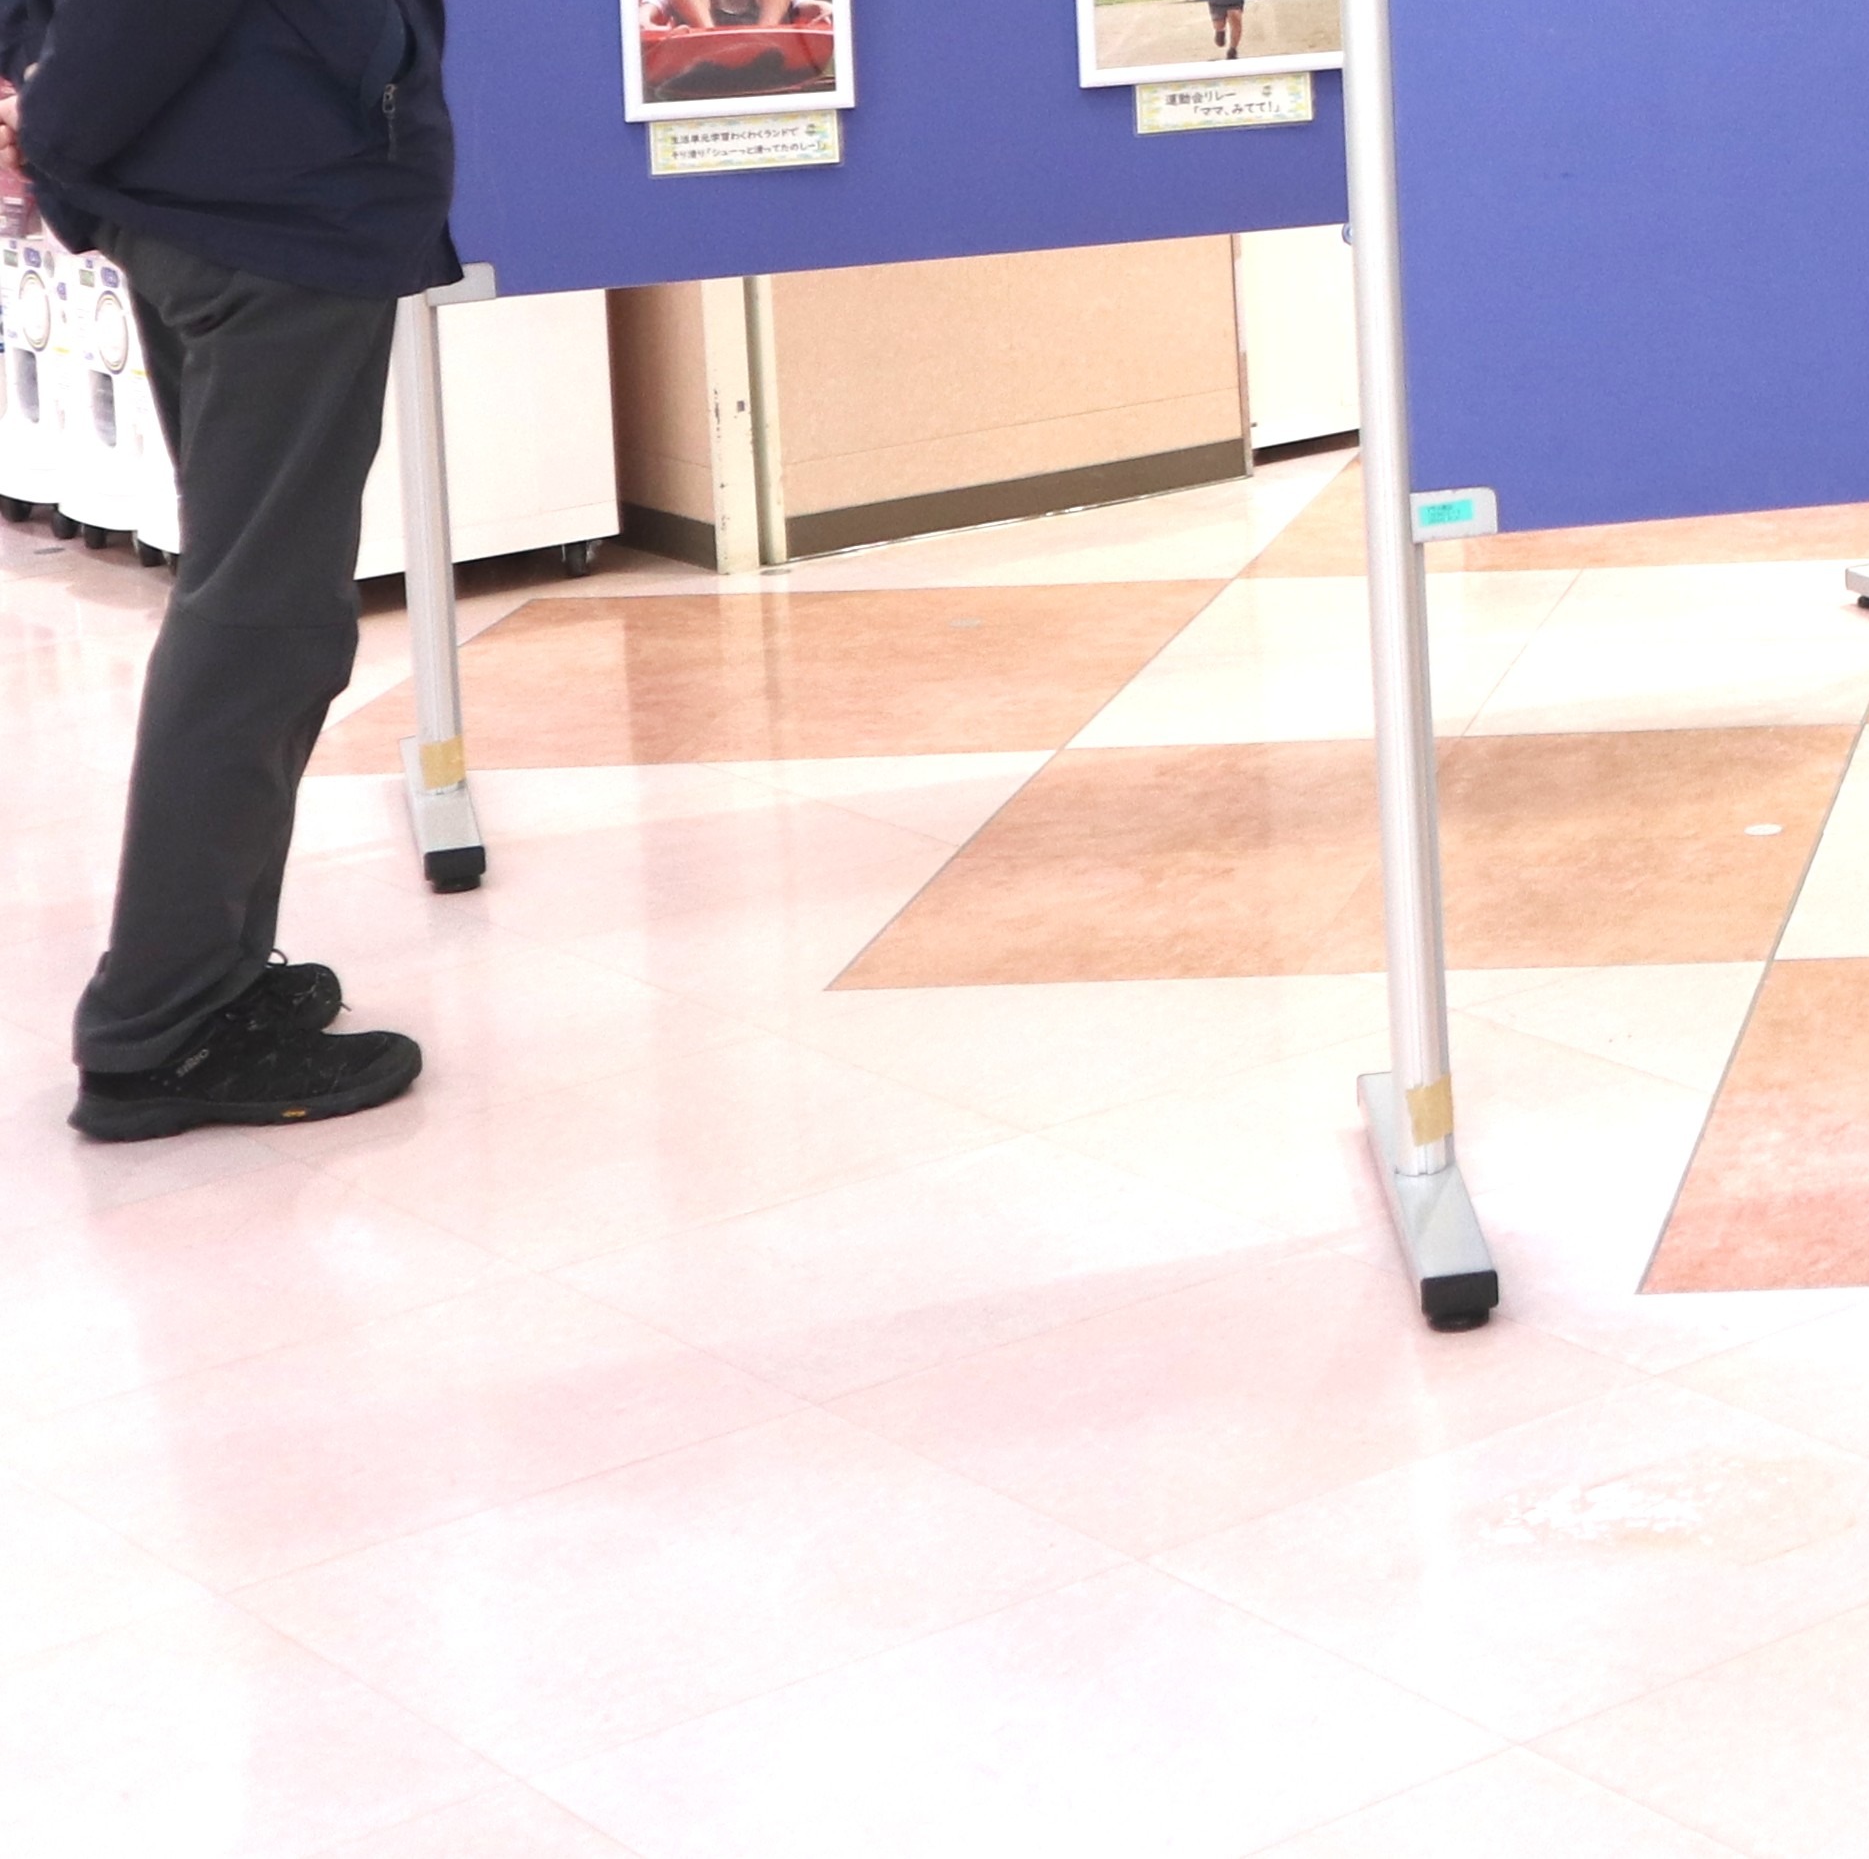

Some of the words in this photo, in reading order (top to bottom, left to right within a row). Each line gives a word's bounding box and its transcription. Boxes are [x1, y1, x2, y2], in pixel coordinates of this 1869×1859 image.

[1165, 90, 1238, 107] 運動会リレー
